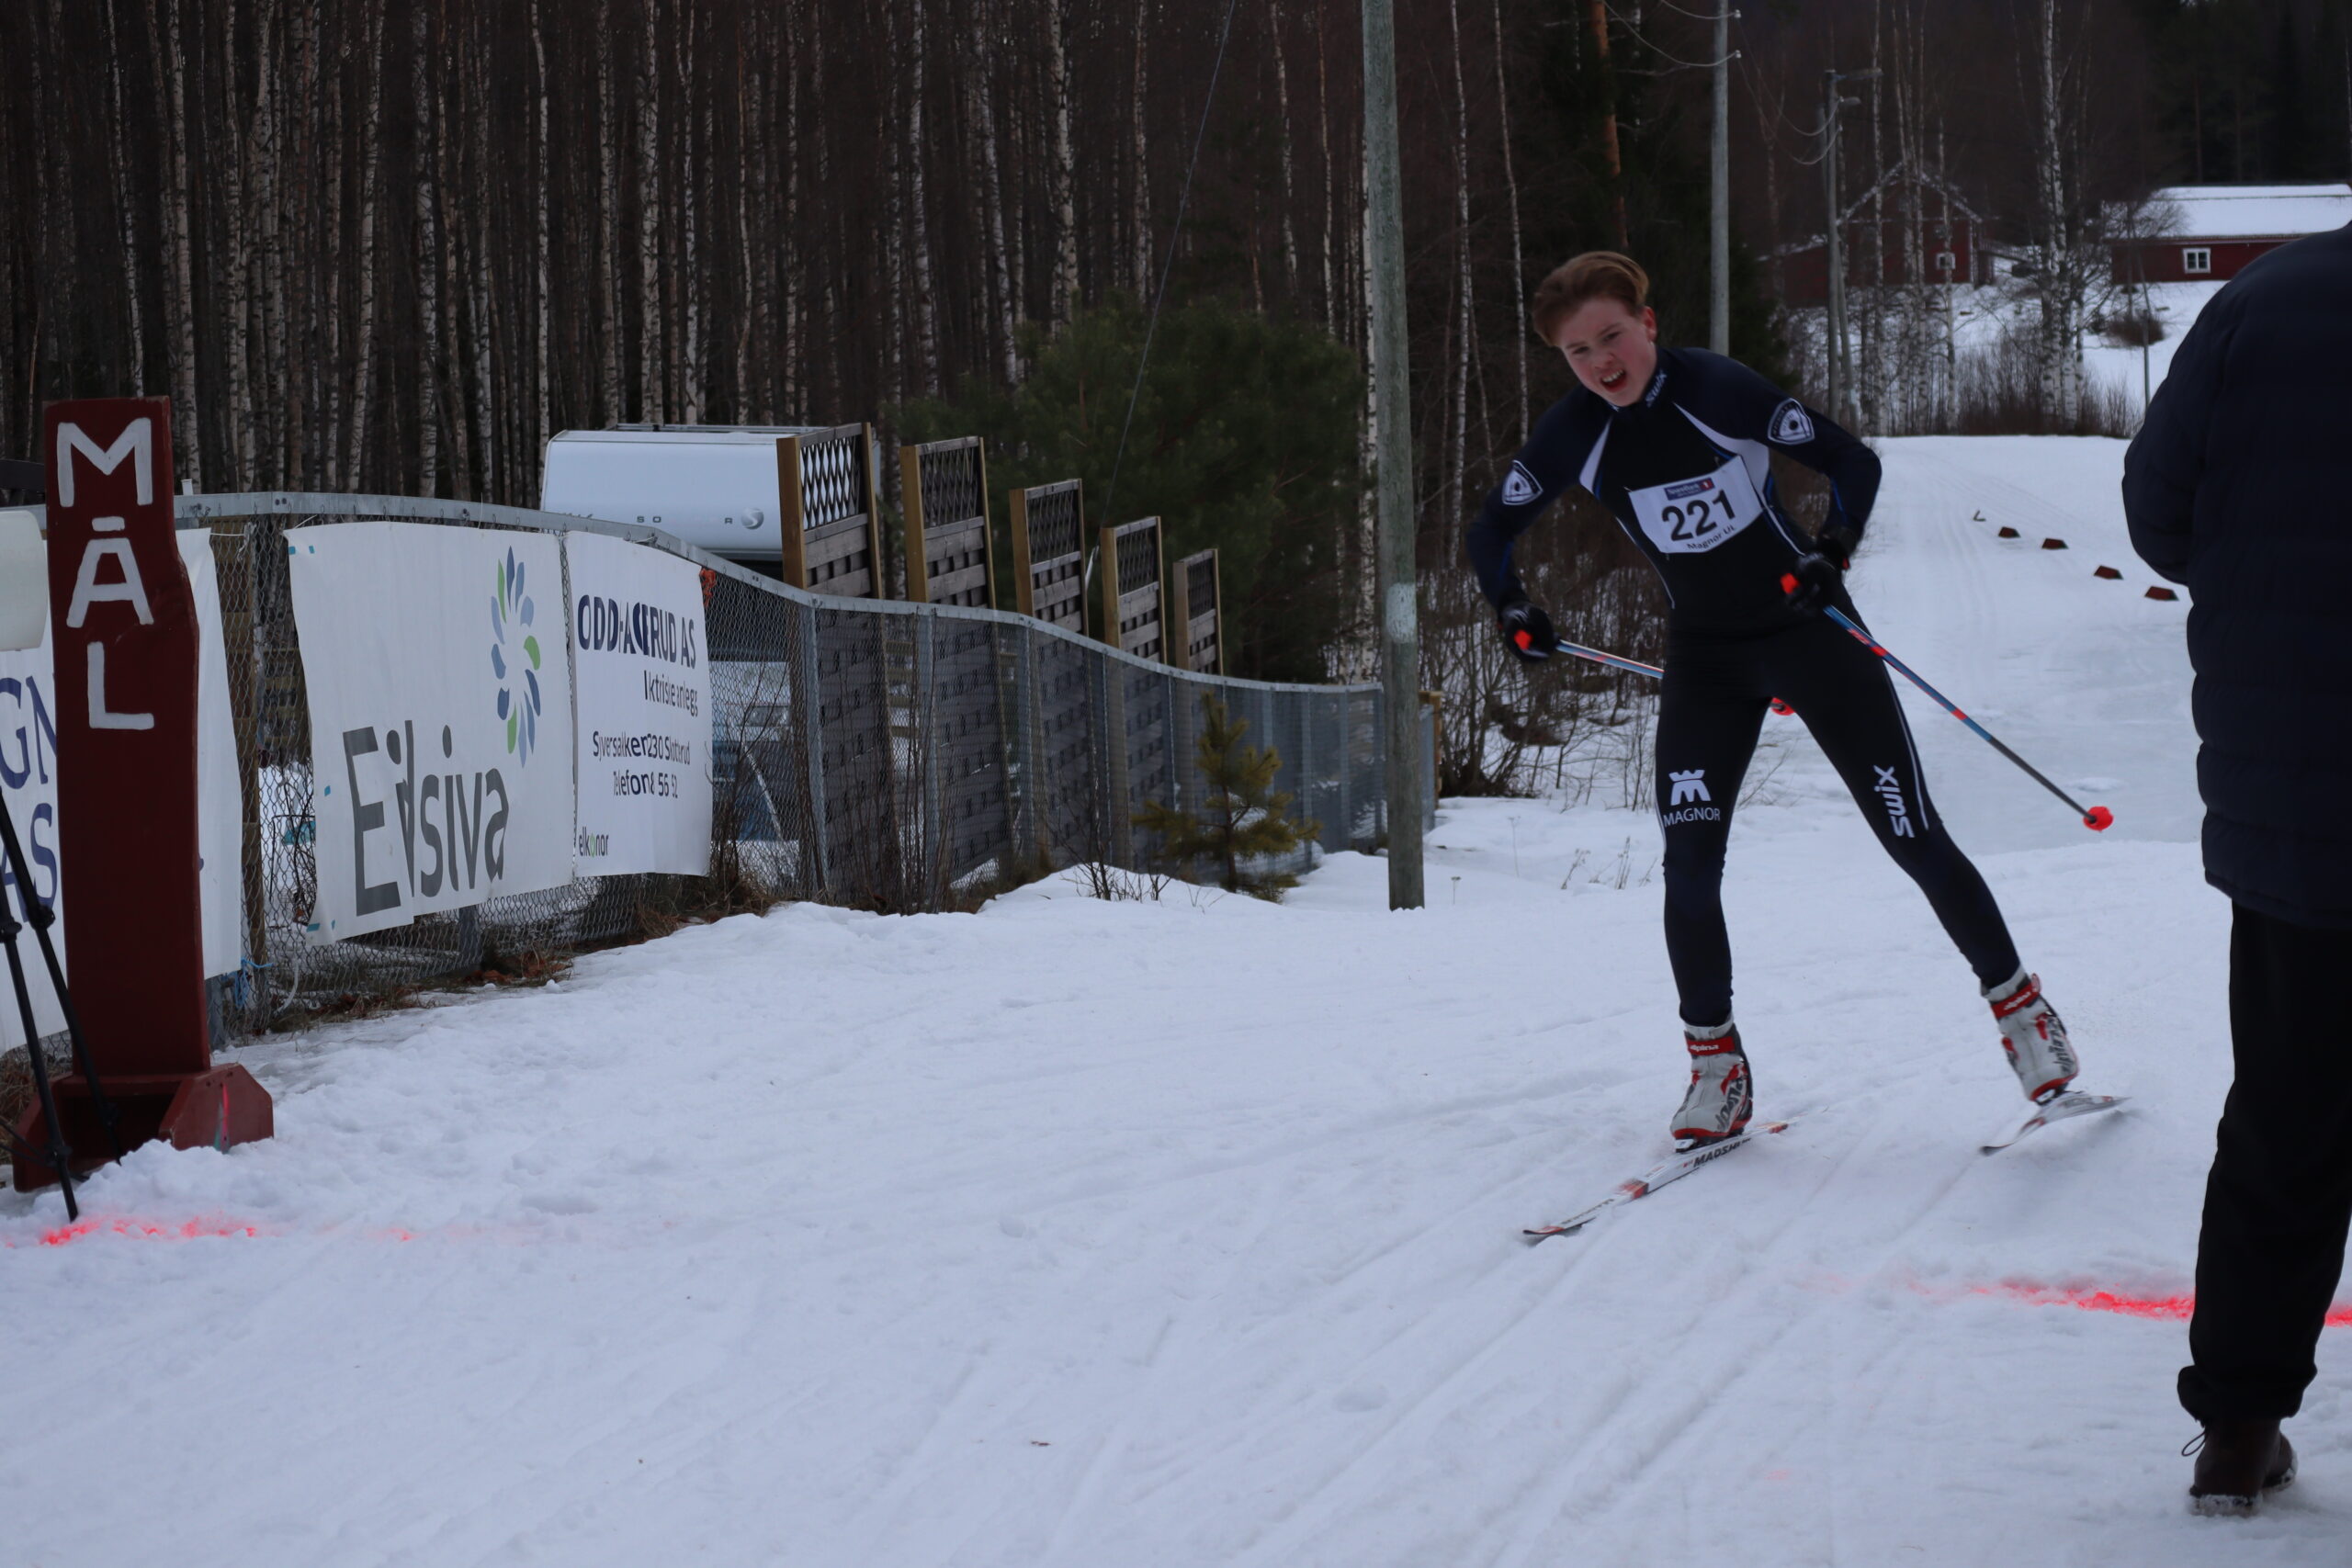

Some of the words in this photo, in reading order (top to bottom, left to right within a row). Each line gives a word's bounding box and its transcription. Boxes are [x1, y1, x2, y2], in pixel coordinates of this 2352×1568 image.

[1661, 489, 1736, 542] 221
[1687, 533, 1723, 551] Magnor
[578, 594, 618, 651] ODD
[681, 616, 696, 669] AS
[1663, 807, 1721, 827] MAGNOR
[1690, 1043, 1719, 1053] alpina
